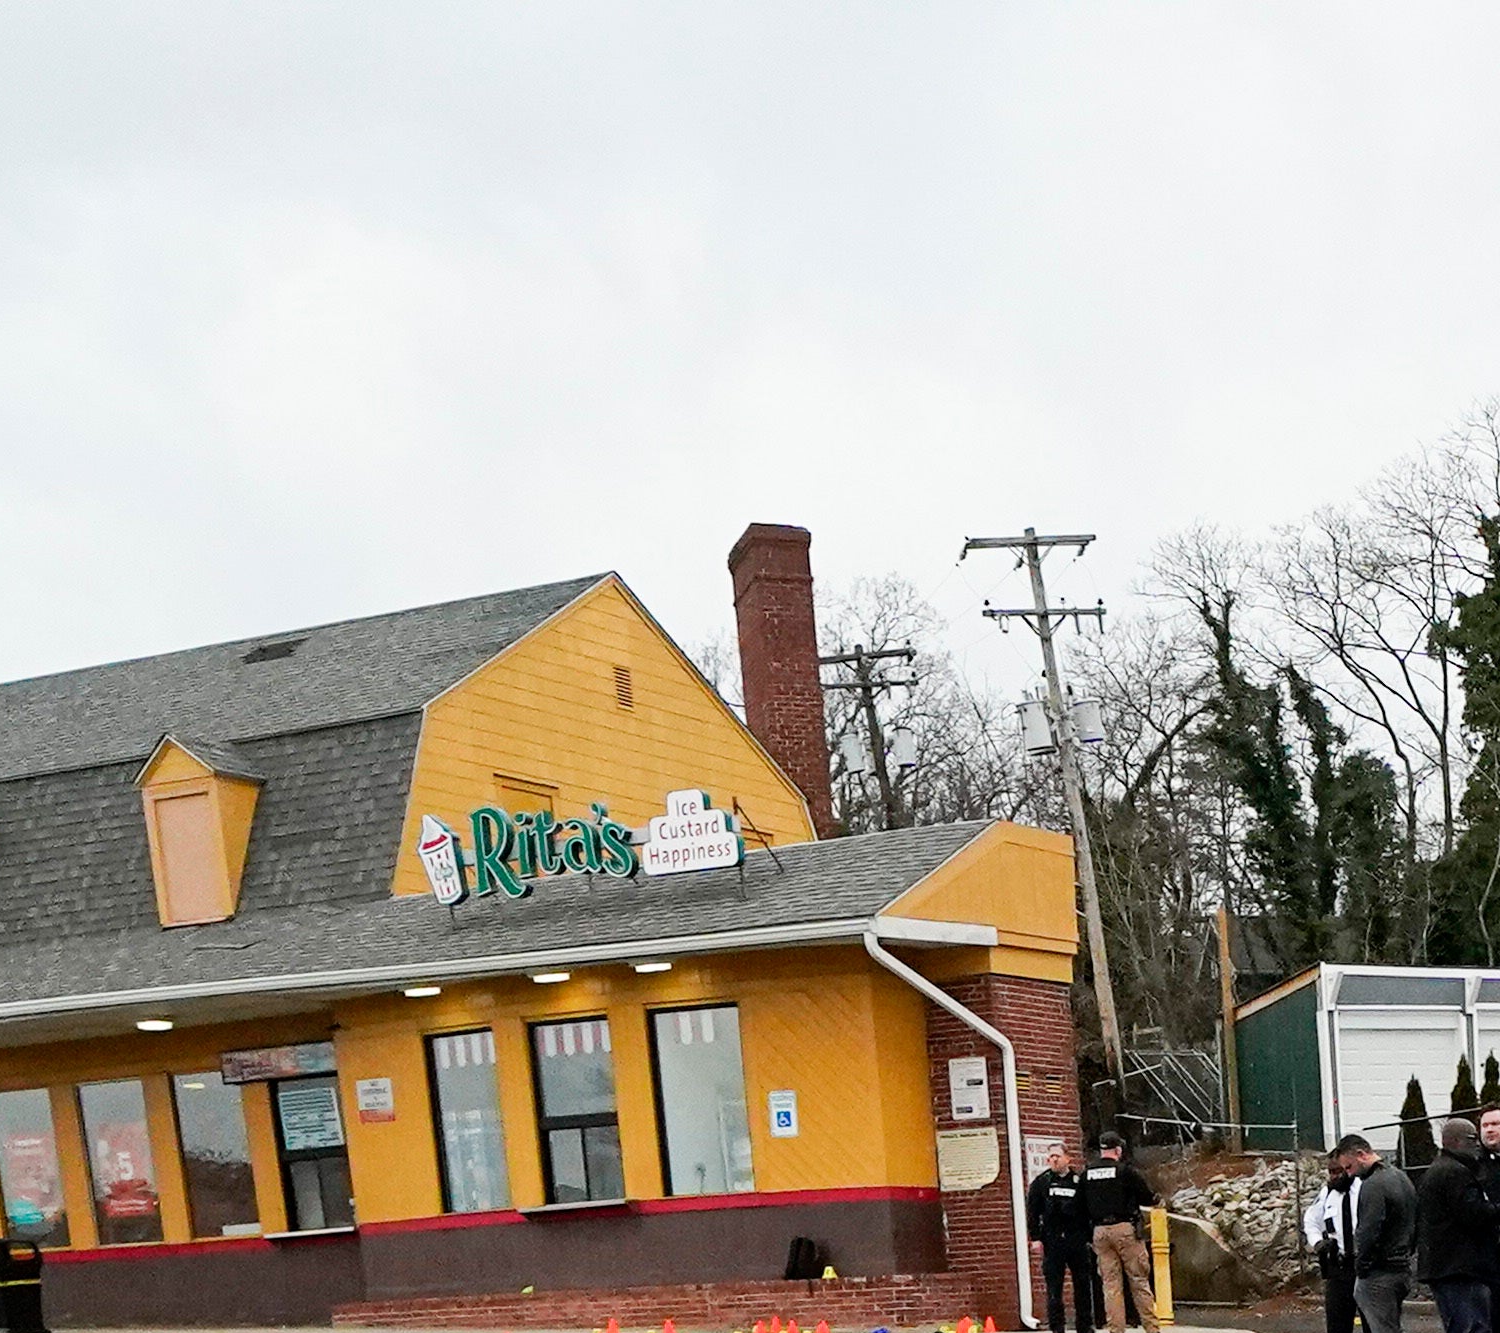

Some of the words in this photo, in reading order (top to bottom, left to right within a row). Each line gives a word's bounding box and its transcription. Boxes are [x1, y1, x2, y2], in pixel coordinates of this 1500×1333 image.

[675, 800, 698, 816] Ice
[658, 818, 721, 841] Custard
[469, 801, 637, 899] Rita's
[649, 841, 731, 868] Happiness
